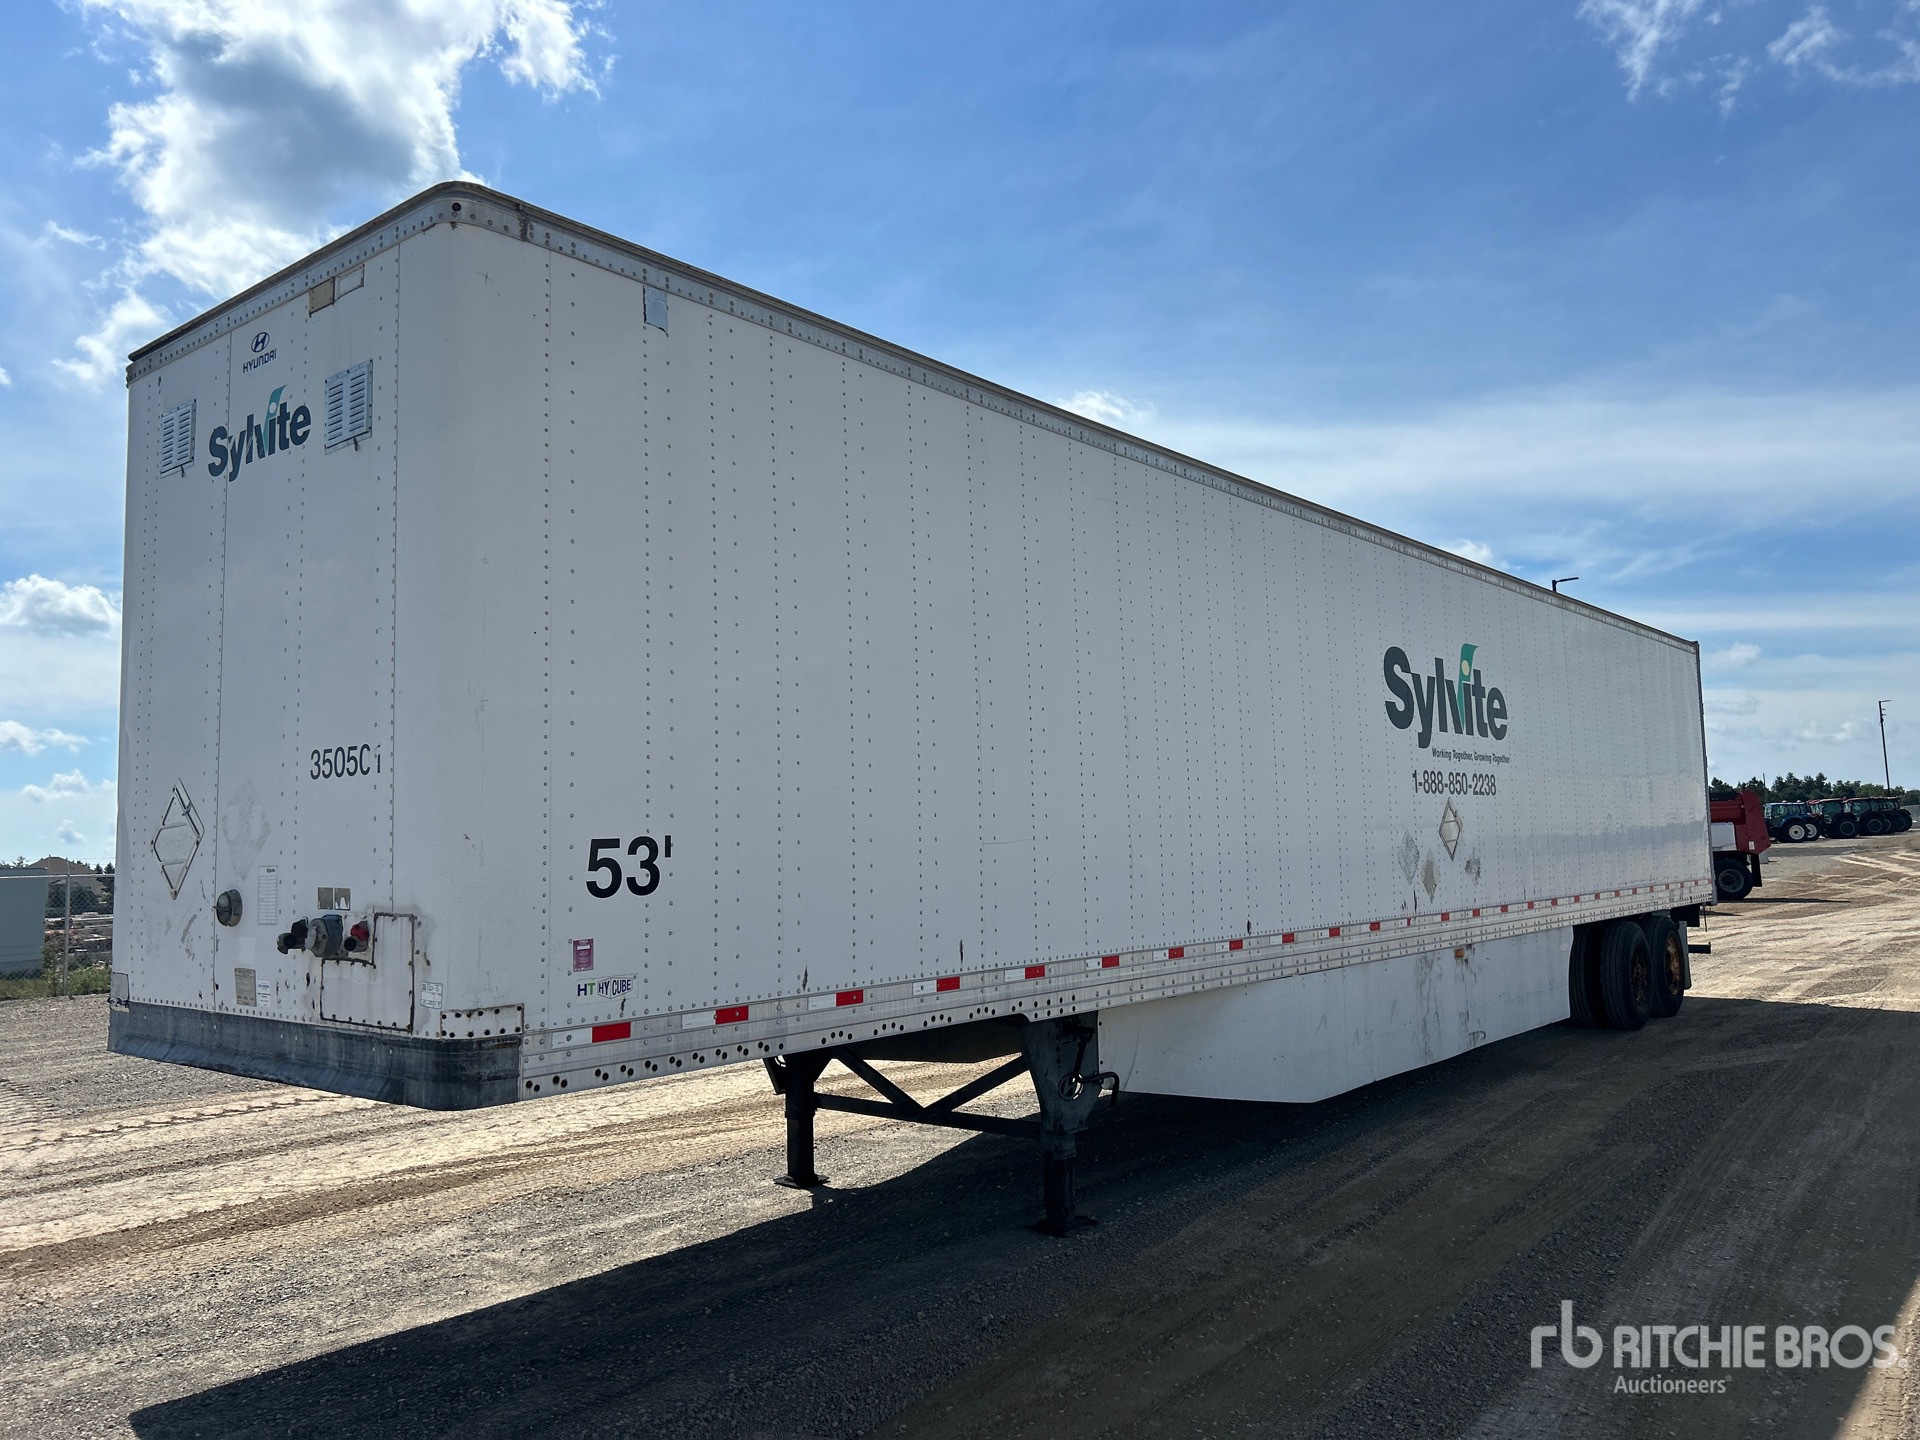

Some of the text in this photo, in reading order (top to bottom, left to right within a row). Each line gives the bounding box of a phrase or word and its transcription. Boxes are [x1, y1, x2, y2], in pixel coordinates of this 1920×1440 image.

[243, 348, 277, 374] HYUNDAI
[207, 384, 312, 482] Sylvite
[1383, 643, 1508, 749] Sylvite
[1432, 747, 1452, 761] Working
[1474, 751, 1492, 764] Growing
[1492, 752, 1511, 766] Together
[1412, 769, 1497, 796] 1-888-850-2238
[577, 979, 632, 997] HT HY CUBE
